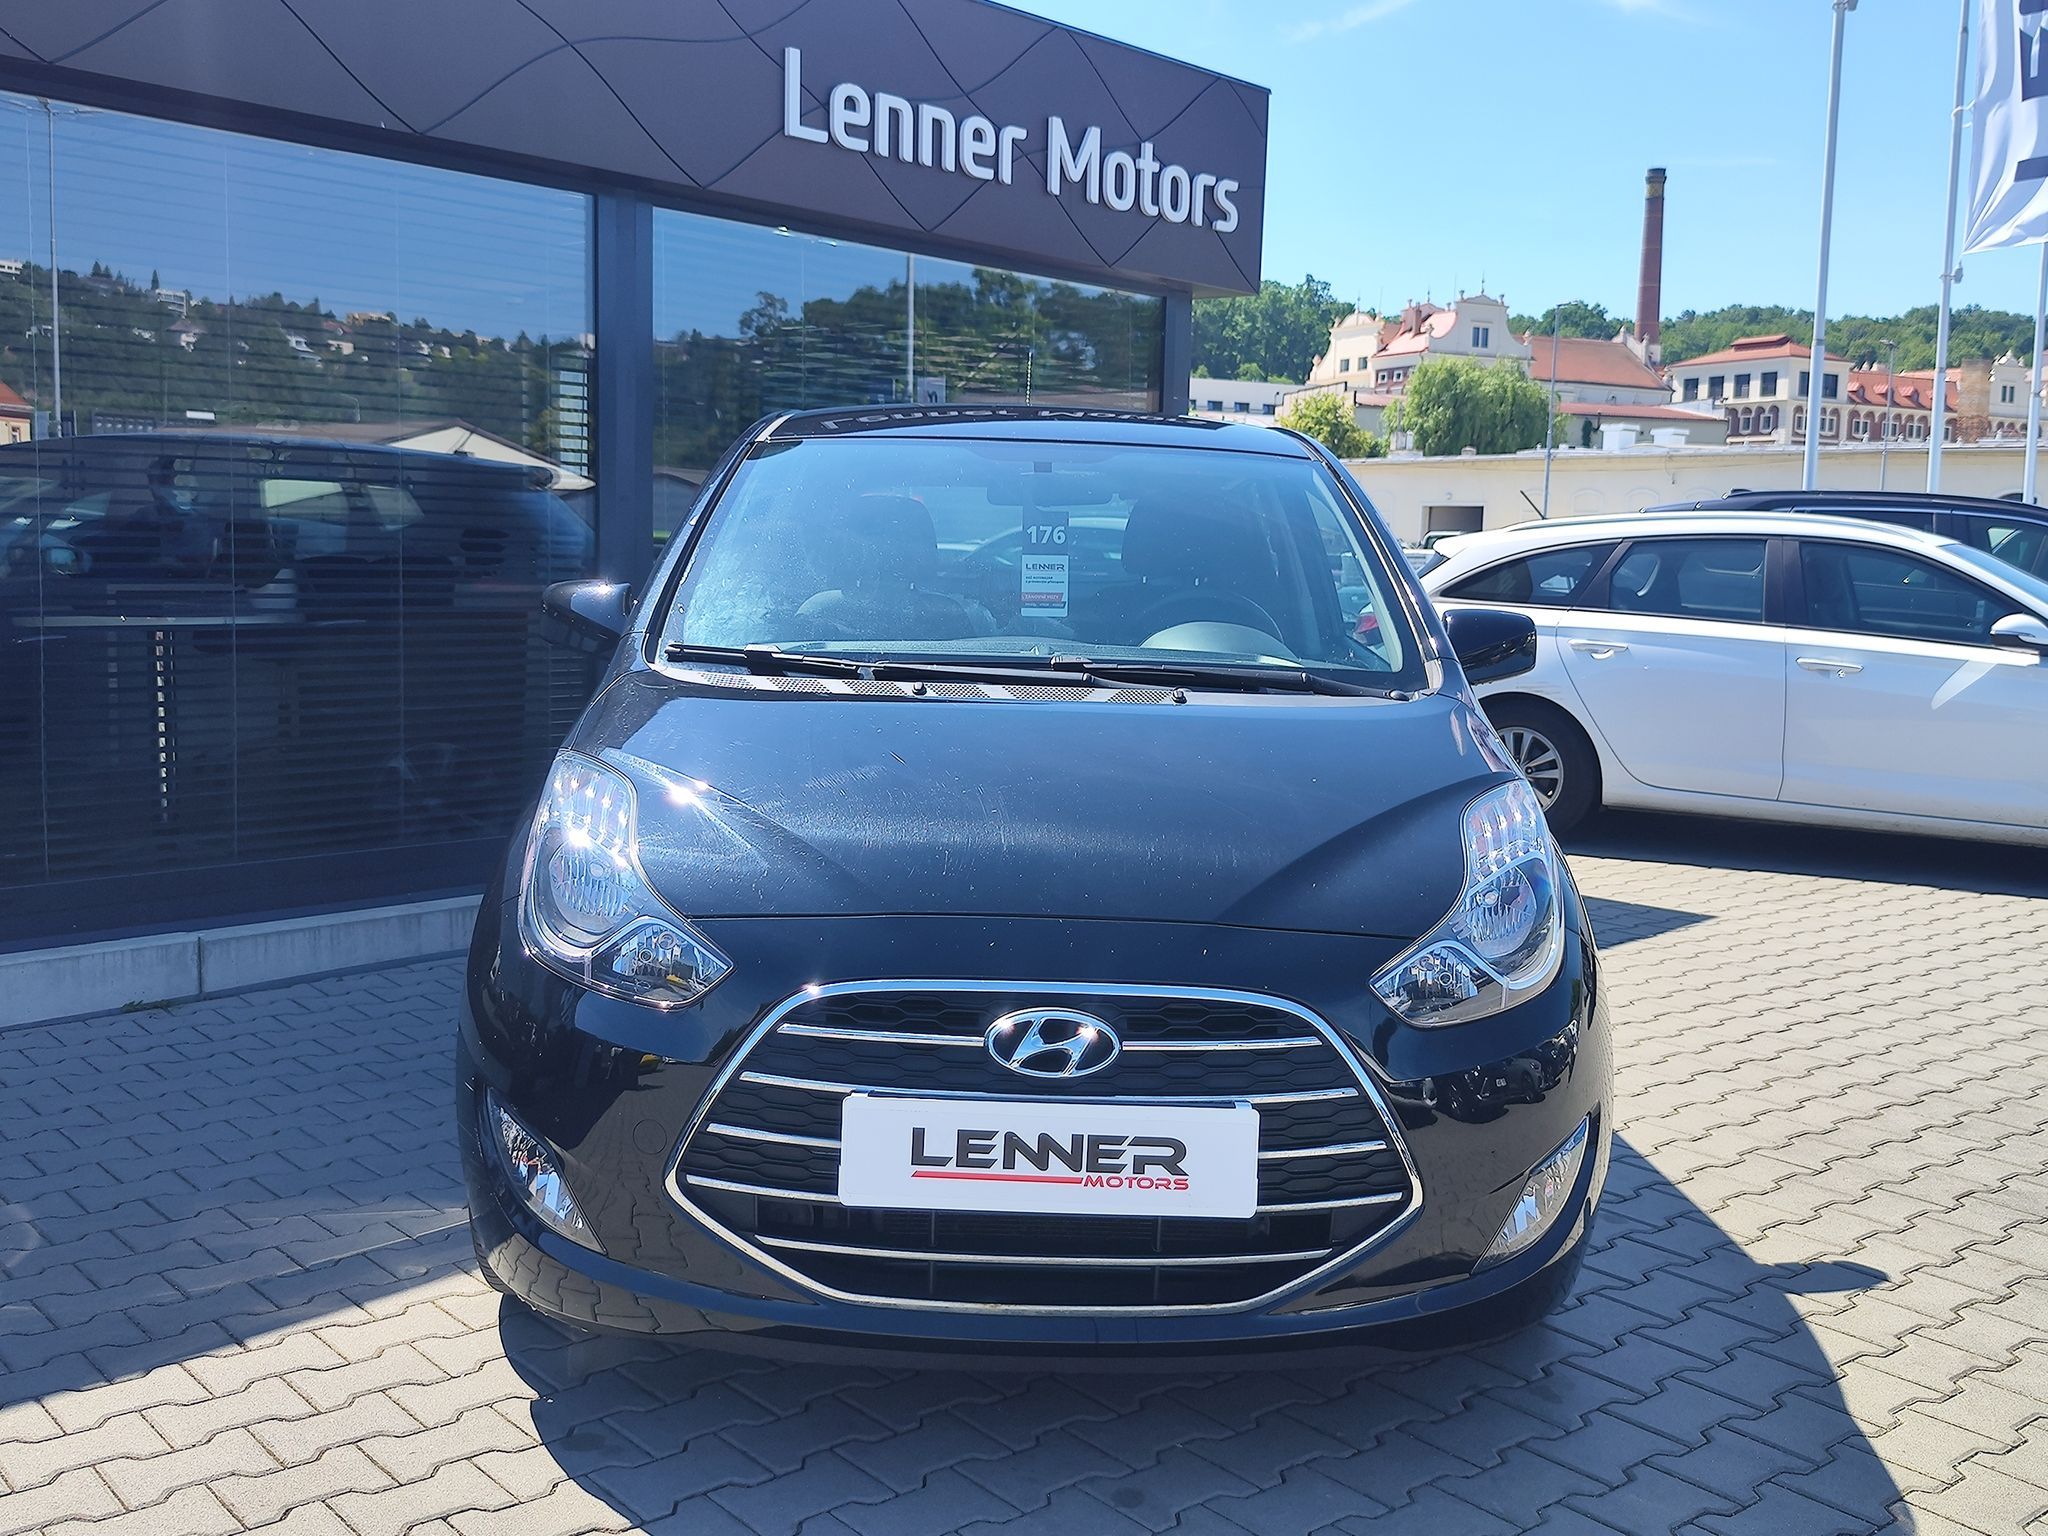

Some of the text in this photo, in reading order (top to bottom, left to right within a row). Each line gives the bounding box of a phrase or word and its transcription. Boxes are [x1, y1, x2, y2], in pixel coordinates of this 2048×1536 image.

[784, 46, 1239, 233] Lenner Motors
[1026, 525, 1066, 544] 176
[1025, 563, 1065, 571] LENNER
[911, 1127, 1189, 1176] LENNER
[1083, 1175, 1190, 1191] MOTORS
